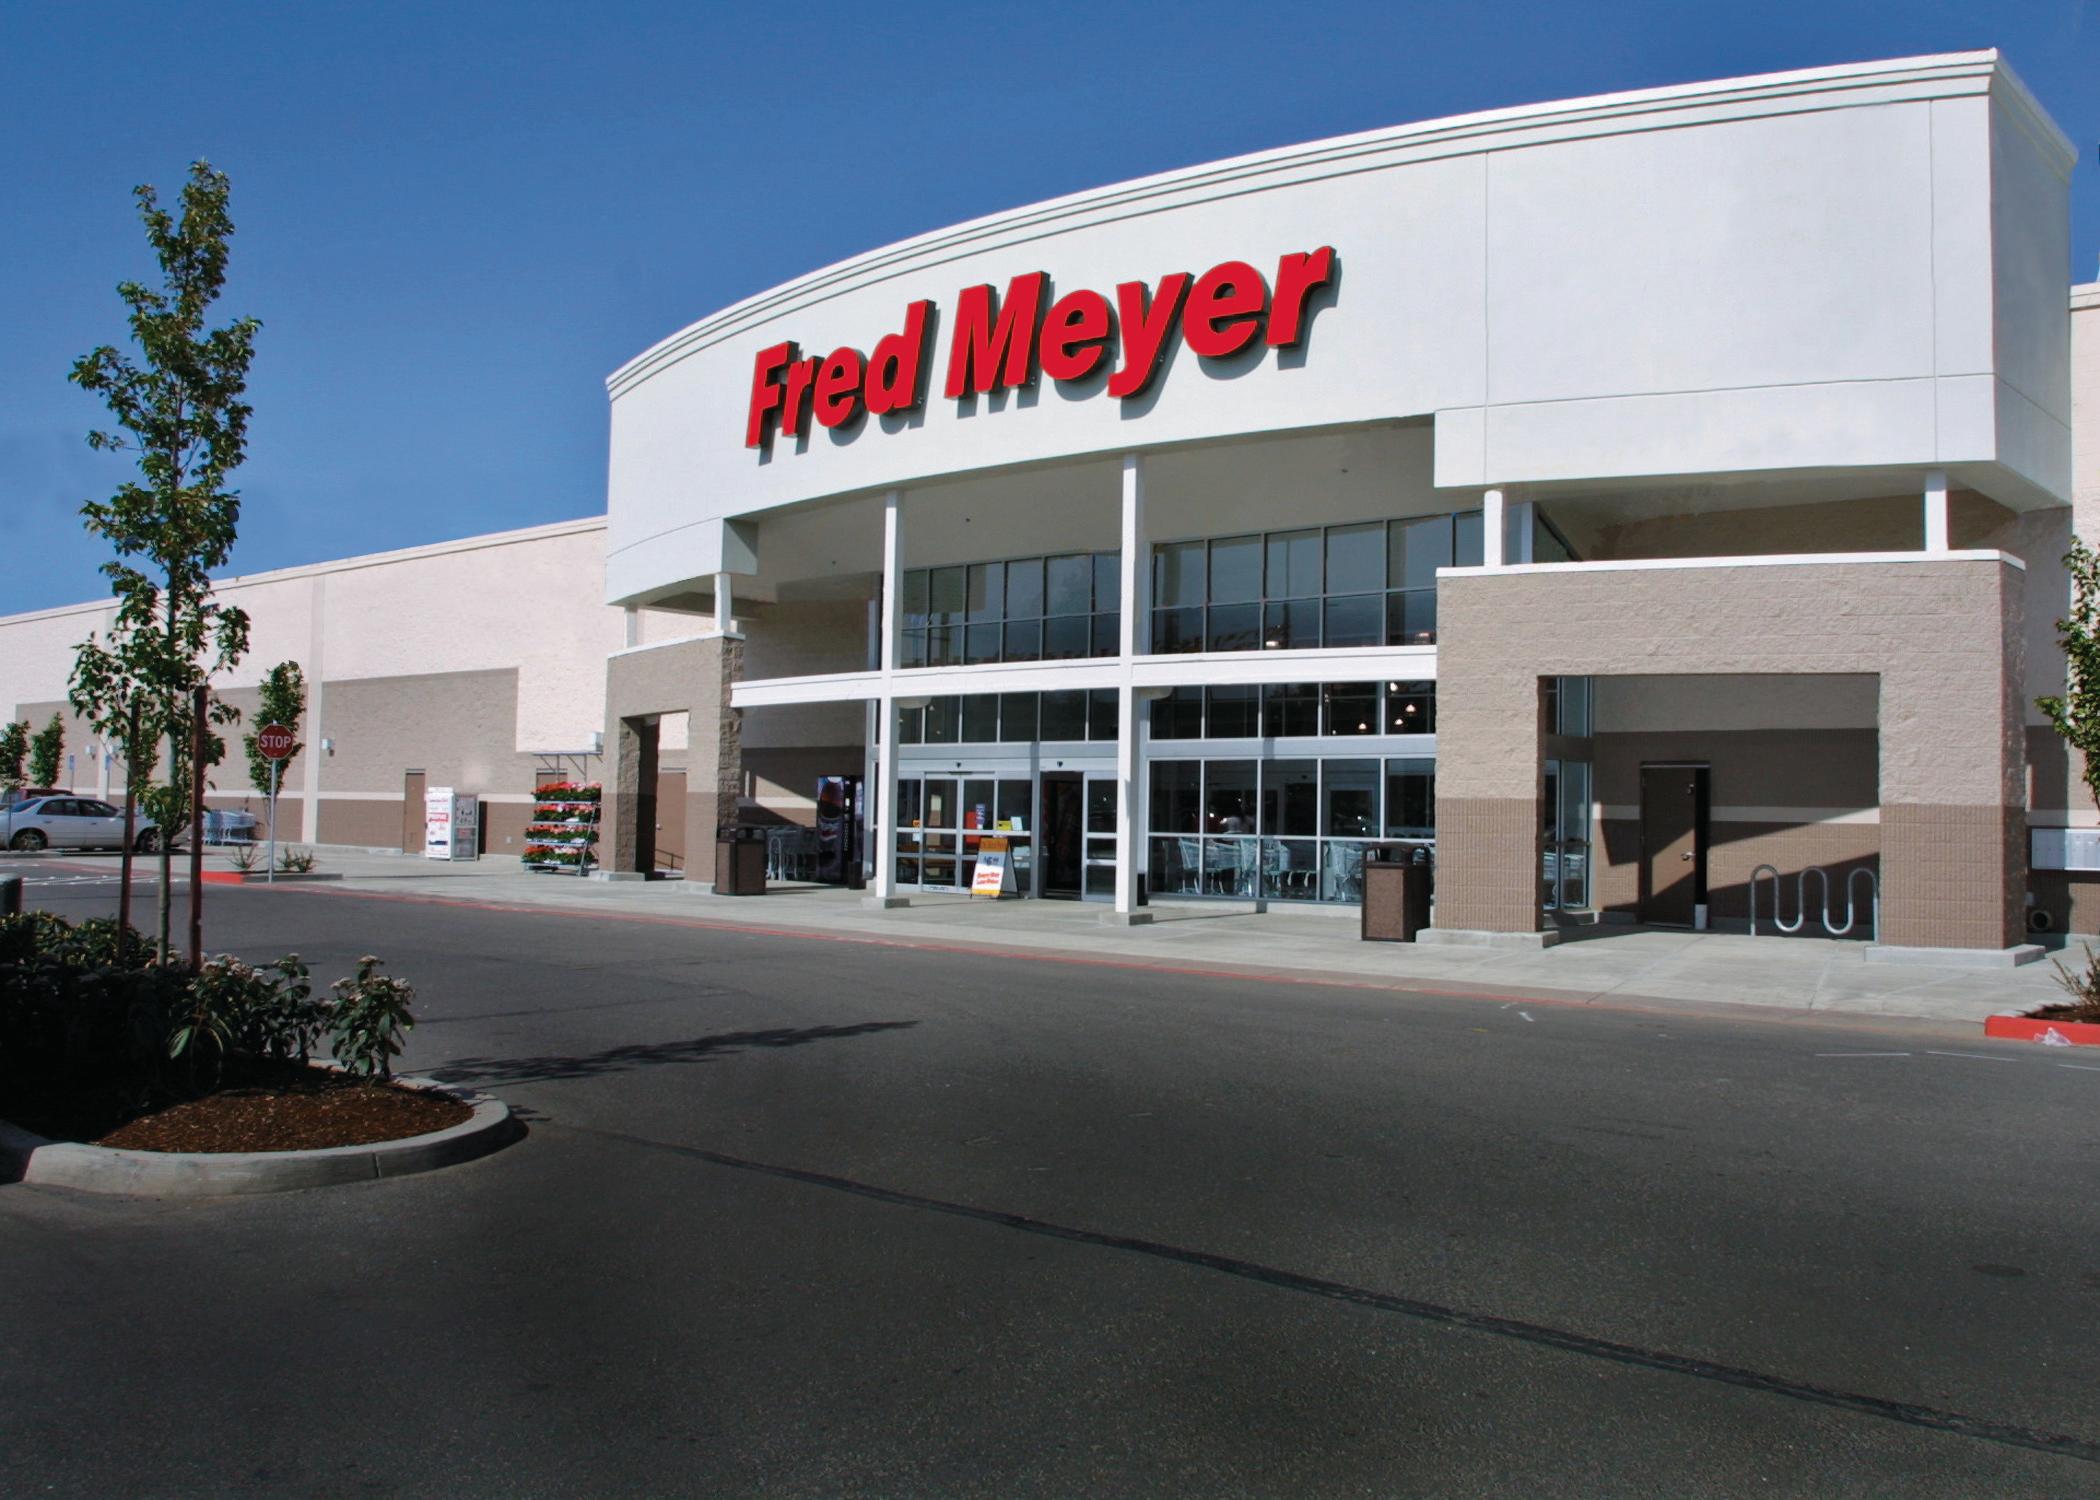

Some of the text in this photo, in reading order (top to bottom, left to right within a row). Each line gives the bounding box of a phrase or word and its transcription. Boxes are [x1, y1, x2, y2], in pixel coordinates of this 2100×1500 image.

[745, 245, 1337, 449] Fred Meyer
[261, 735, 292, 748] STOP
